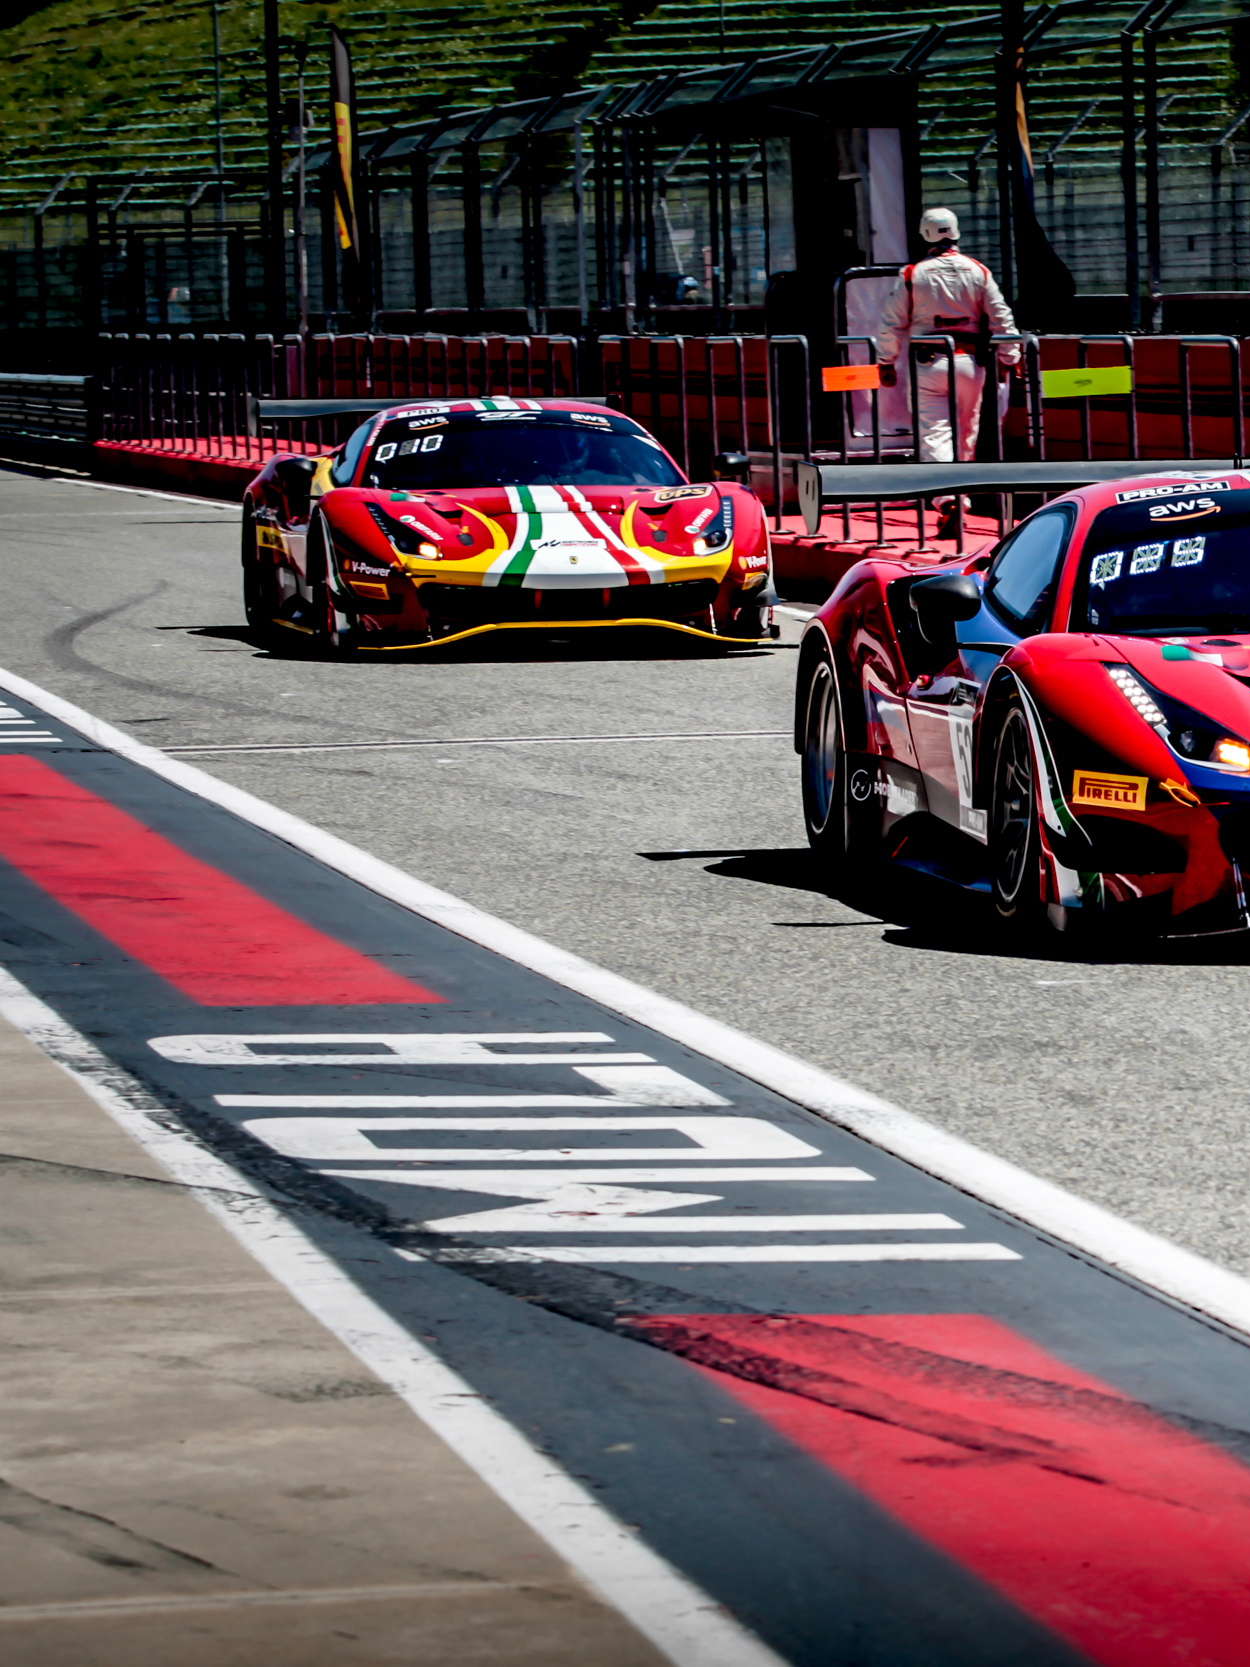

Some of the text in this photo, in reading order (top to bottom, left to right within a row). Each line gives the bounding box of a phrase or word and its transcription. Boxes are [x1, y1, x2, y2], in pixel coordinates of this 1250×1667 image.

[408, 416, 447, 428] aws
[570, 412, 608, 423] aws
[659, 486, 706, 500] ups
[1122, 481, 1224, 501] PRO-AM
[1149, 497, 1216, 518] aws
[351, 560, 391, 577] V-Power
[1078, 776, 1139, 804] PIRELLI
[146, 1032, 1024, 1264] IMOLA
